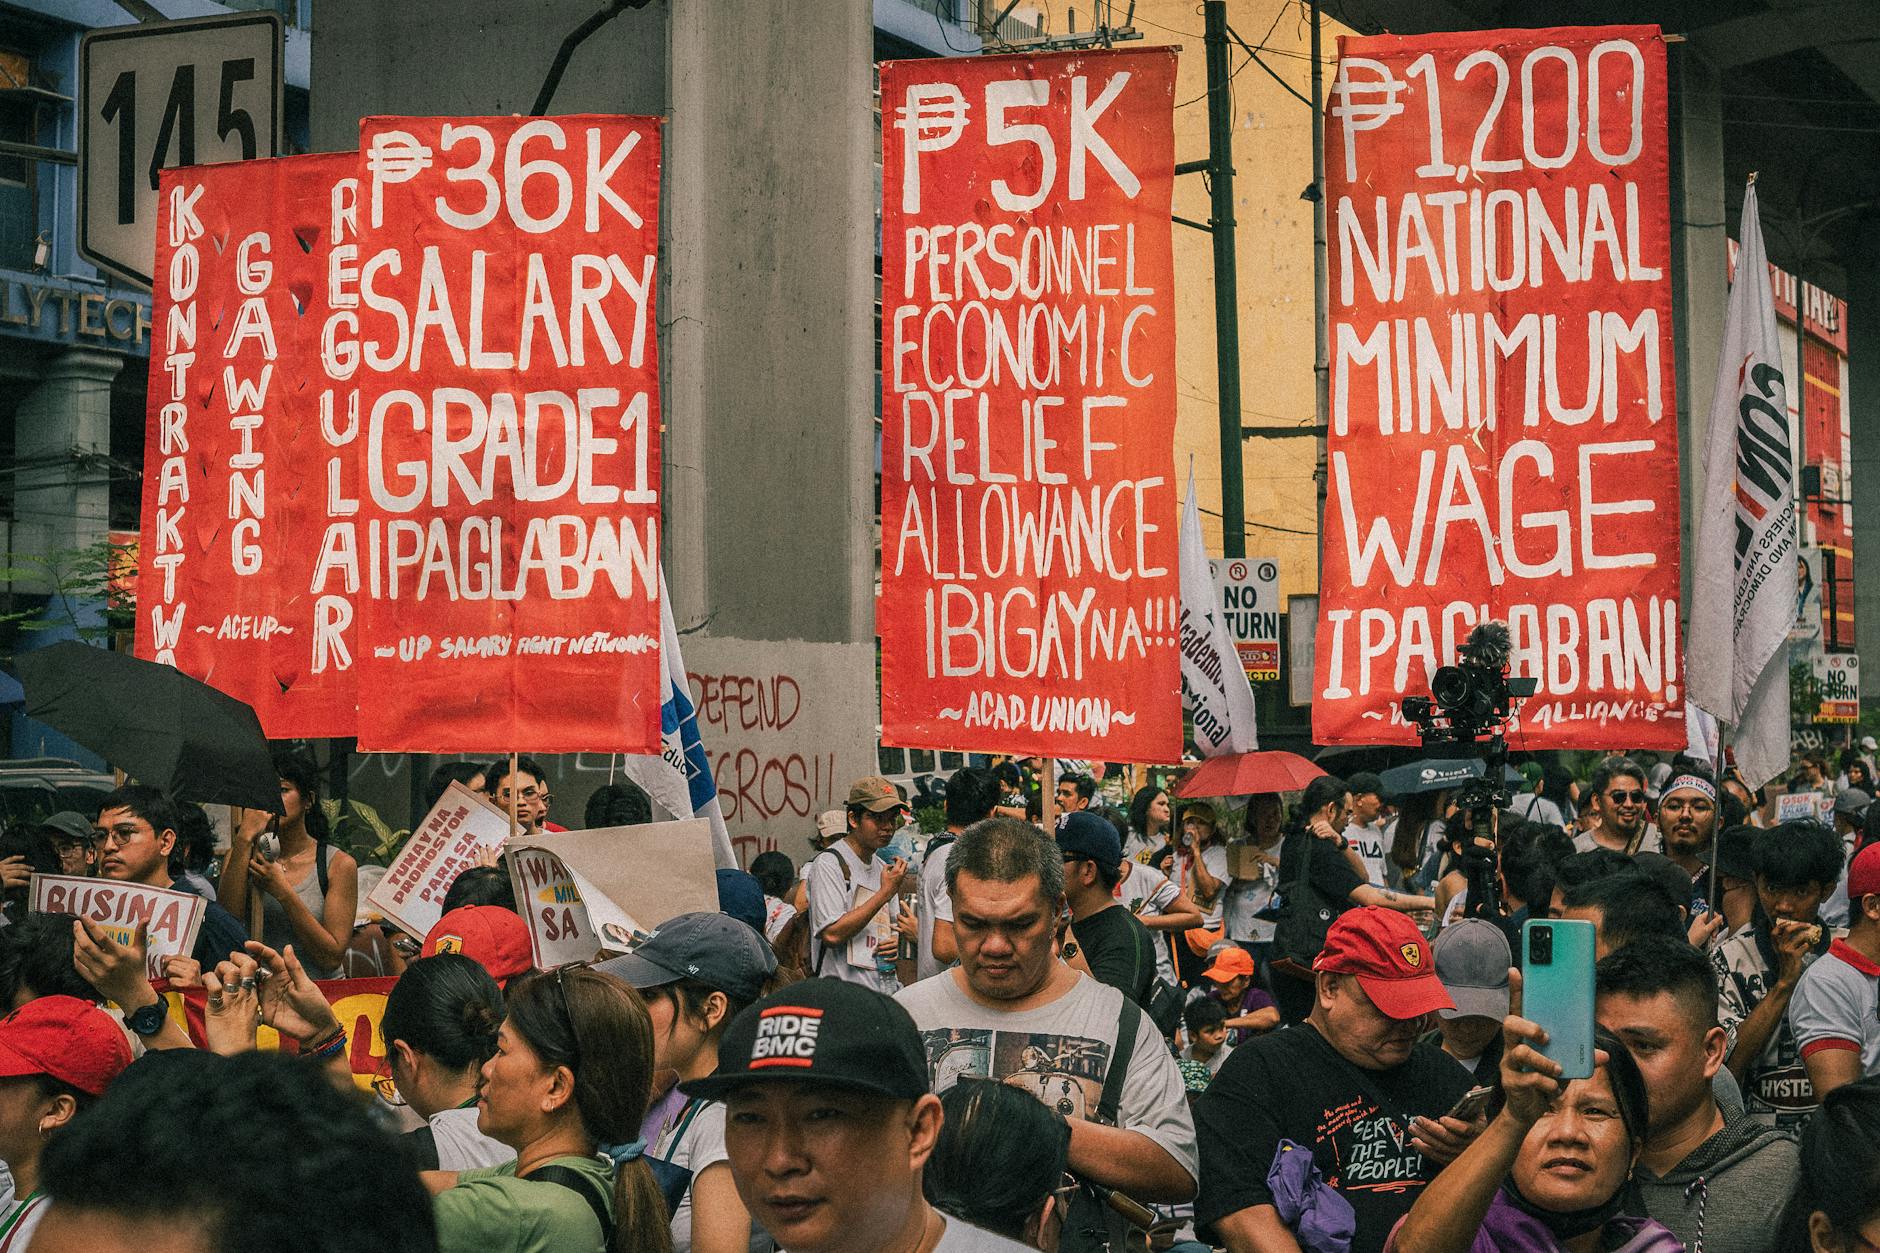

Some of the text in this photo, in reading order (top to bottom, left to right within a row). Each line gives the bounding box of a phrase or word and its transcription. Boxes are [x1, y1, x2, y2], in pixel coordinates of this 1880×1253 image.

[101, 57, 256, 225] 145
[904, 223, 1154, 302] PERSONNEL
[1338, 181, 1662, 306] NATIONAL
[362, 246, 656, 372] SALARY
[893, 300, 1156, 393] ECONOMIC
[223, 232, 278, 575] GAWING
[1333, 308, 1662, 437] MINIMUM
[311, 178, 358, 673] REGULAR
[903, 389, 1128, 486] RELIEF
[895, 476, 1168, 581] ALLOWANCE
[1333, 440, 1656, 587] WAGE
[369, 515, 658, 601] IPAGLABAN
[1224, 586, 1257, 609] NO
[438, 635, 513, 659] SALARY
[925, 584, 1096, 681] IBIGAY
[1323, 596, 1678, 702] IPAGABAN!
[687, 672, 800, 733] DEFEND
[707, 748, 834, 823] GROS!!
[387, 808, 451, 886] TUNAY NA
[392, 805, 470, 905] PROMOSYON
[420, 832, 477, 902] PARA SA
[47, 885, 180, 942] BUSINA
[541, 906, 579, 942] SA
[751, 1035, 816, 1059] BMC
[756, 1015, 821, 1038] RIDE
[1346, 1154, 1423, 1180] PEOPLE!
[1351, 1140, 1387, 1163] THE
